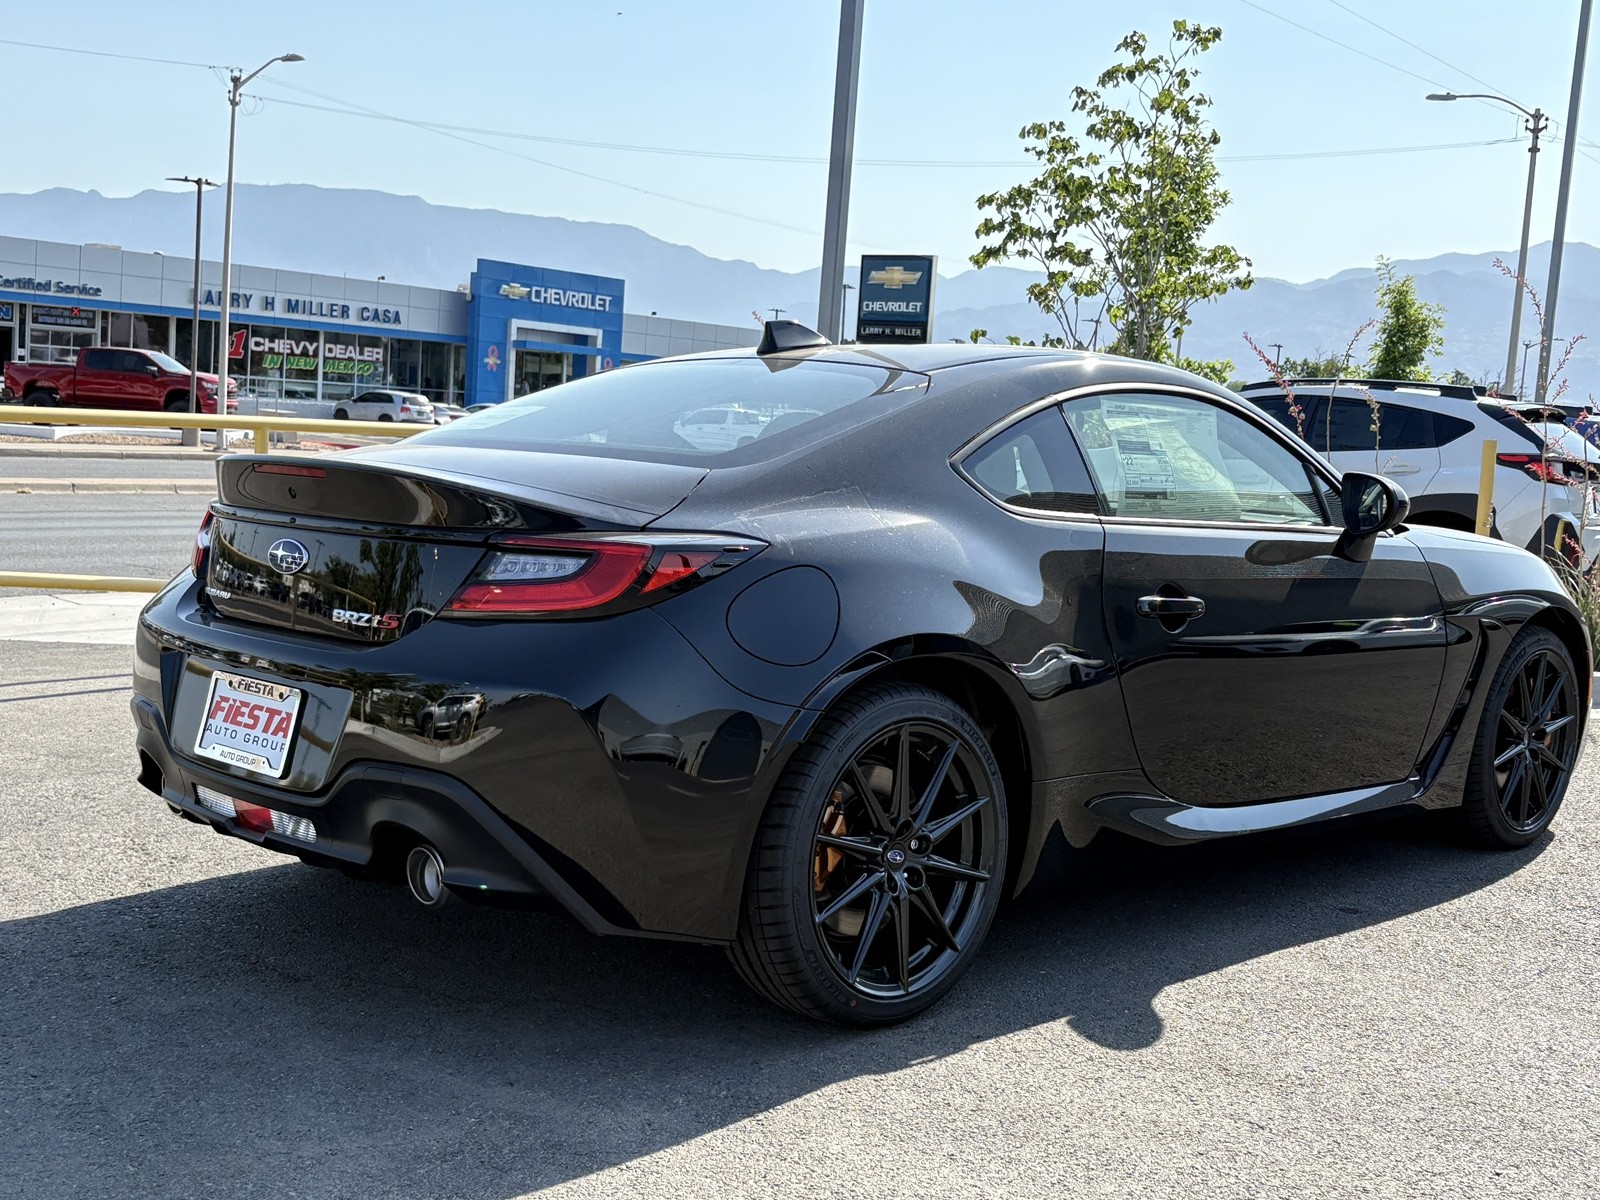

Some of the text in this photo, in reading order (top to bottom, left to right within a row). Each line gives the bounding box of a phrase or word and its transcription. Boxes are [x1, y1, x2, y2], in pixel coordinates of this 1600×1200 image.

[54, 281, 102, 297] Service
[197, 289, 402, 325] ARY H MILLER CASA
[531, 285, 613, 312] CHEVROLET
[863, 301, 923, 313] CHEVROLET
[861, 327, 883, 335] LARRY
[895, 328, 922, 336] MILLER
[251, 337, 318, 356] CHEVY
[325, 343, 384, 362] DEALER
[262, 354, 282, 369] IN
[286, 356, 318, 370] NEW
[332, 609, 372, 627] BRZ
[237, 679, 274, 698] FIESTA
[209, 694, 293, 740] FIESTA
[205, 723, 238, 740] AUTO
[219, 750, 257, 766] AUTO GROUP
